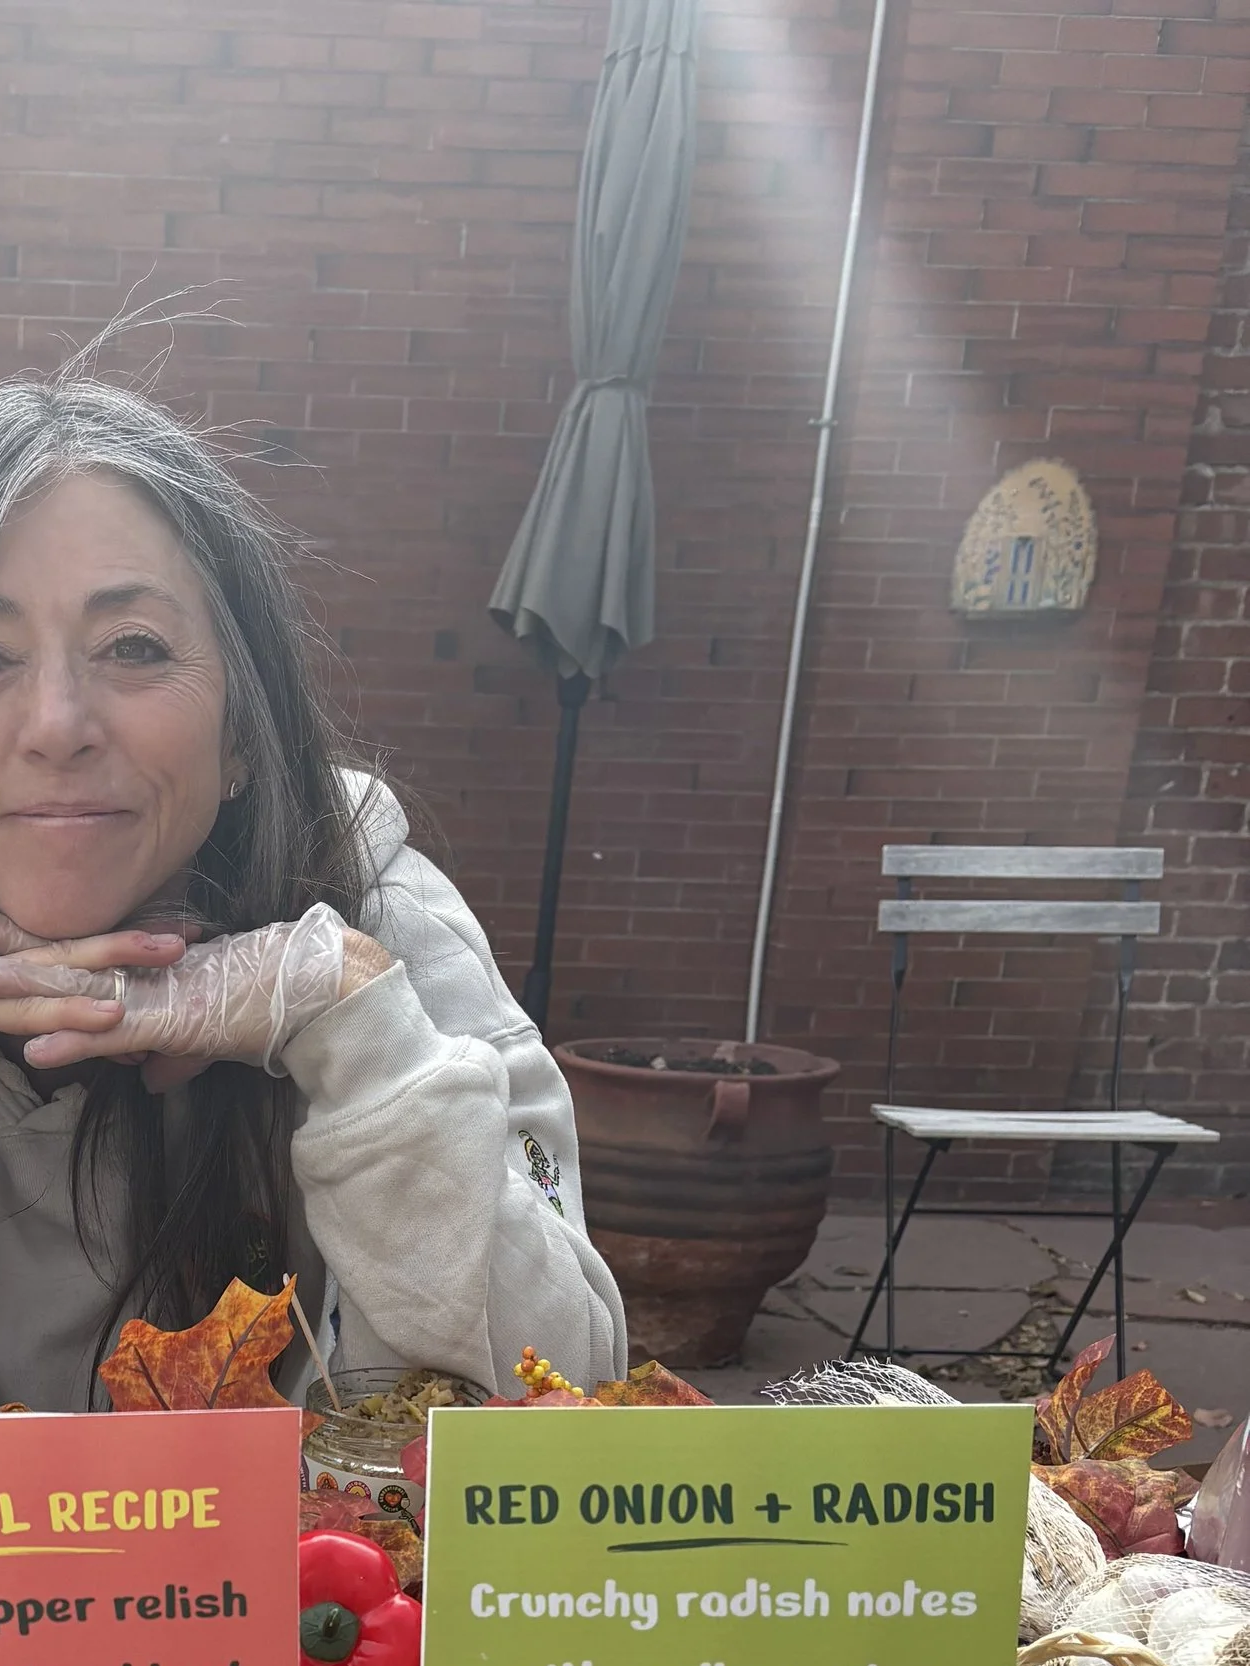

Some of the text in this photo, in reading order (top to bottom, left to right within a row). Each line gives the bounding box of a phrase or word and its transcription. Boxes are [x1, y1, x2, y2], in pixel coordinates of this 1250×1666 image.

[48, 1486, 222, 1533] RECIPE
[463, 1481, 996, 1527] RED ONION + RADISH
[113, 1579, 249, 1622] relish
[469, 1577, 979, 1631] Crunchy radish notes
